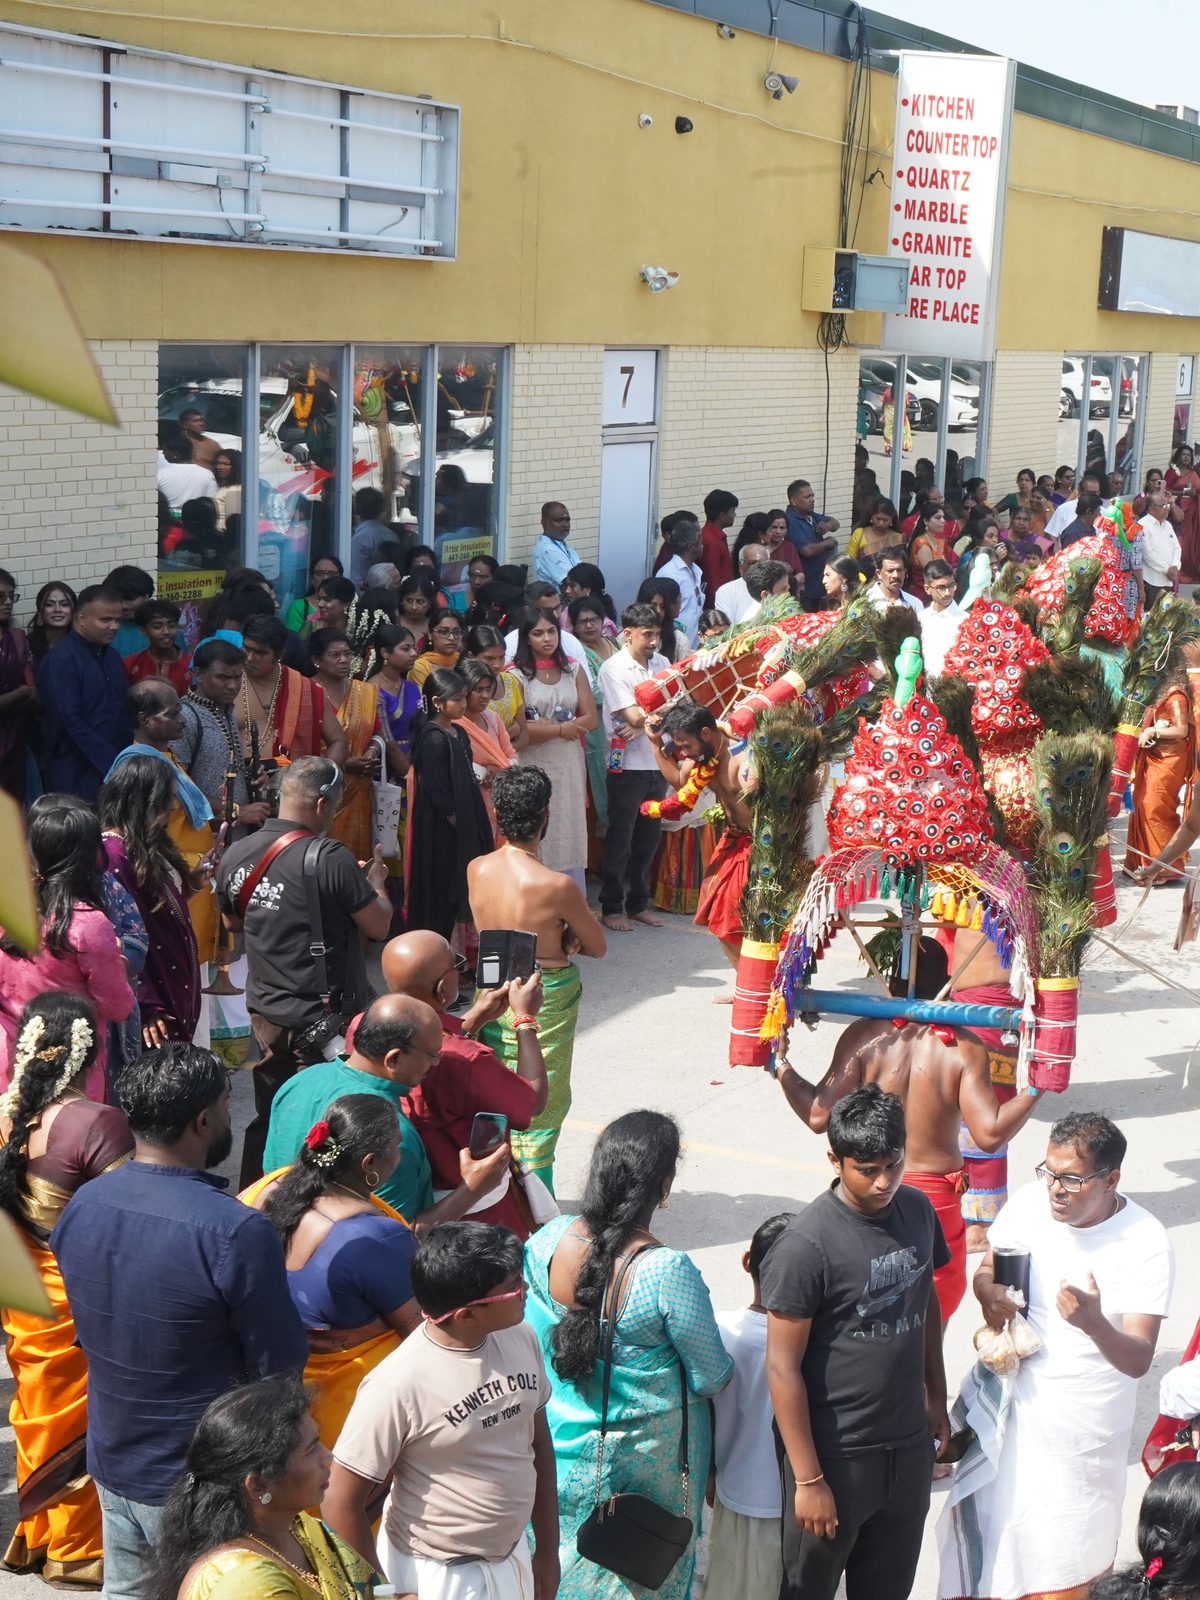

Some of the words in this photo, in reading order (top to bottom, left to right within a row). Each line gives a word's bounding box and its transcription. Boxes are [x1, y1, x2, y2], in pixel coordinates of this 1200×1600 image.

[911, 93, 975, 120] KITCHEN
[906, 129, 969, 157] COUNTER
[972, 134, 997, 159] TOP
[906, 166, 971, 191] QUARTZ
[904, 199, 969, 225] MARBLE
[902, 231, 973, 258] GRANITE
[909, 265, 931, 287] AR
[936, 267, 967, 290] TOP
[896, 297, 929, 319] RE
[932, 299, 980, 324] PLACE
[620, 366, 635, 409] 7
[1179, 363, 1185, 388] 6
[165, 577, 212, 592] Insulation
[896, 1313, 921, 1335] MA
[444, 1379, 504, 1427] KENNETH
[506, 1373, 538, 1392] COLE
[481, 1413, 499, 1429] NEW
[501, 1403, 522, 1420] YORK
